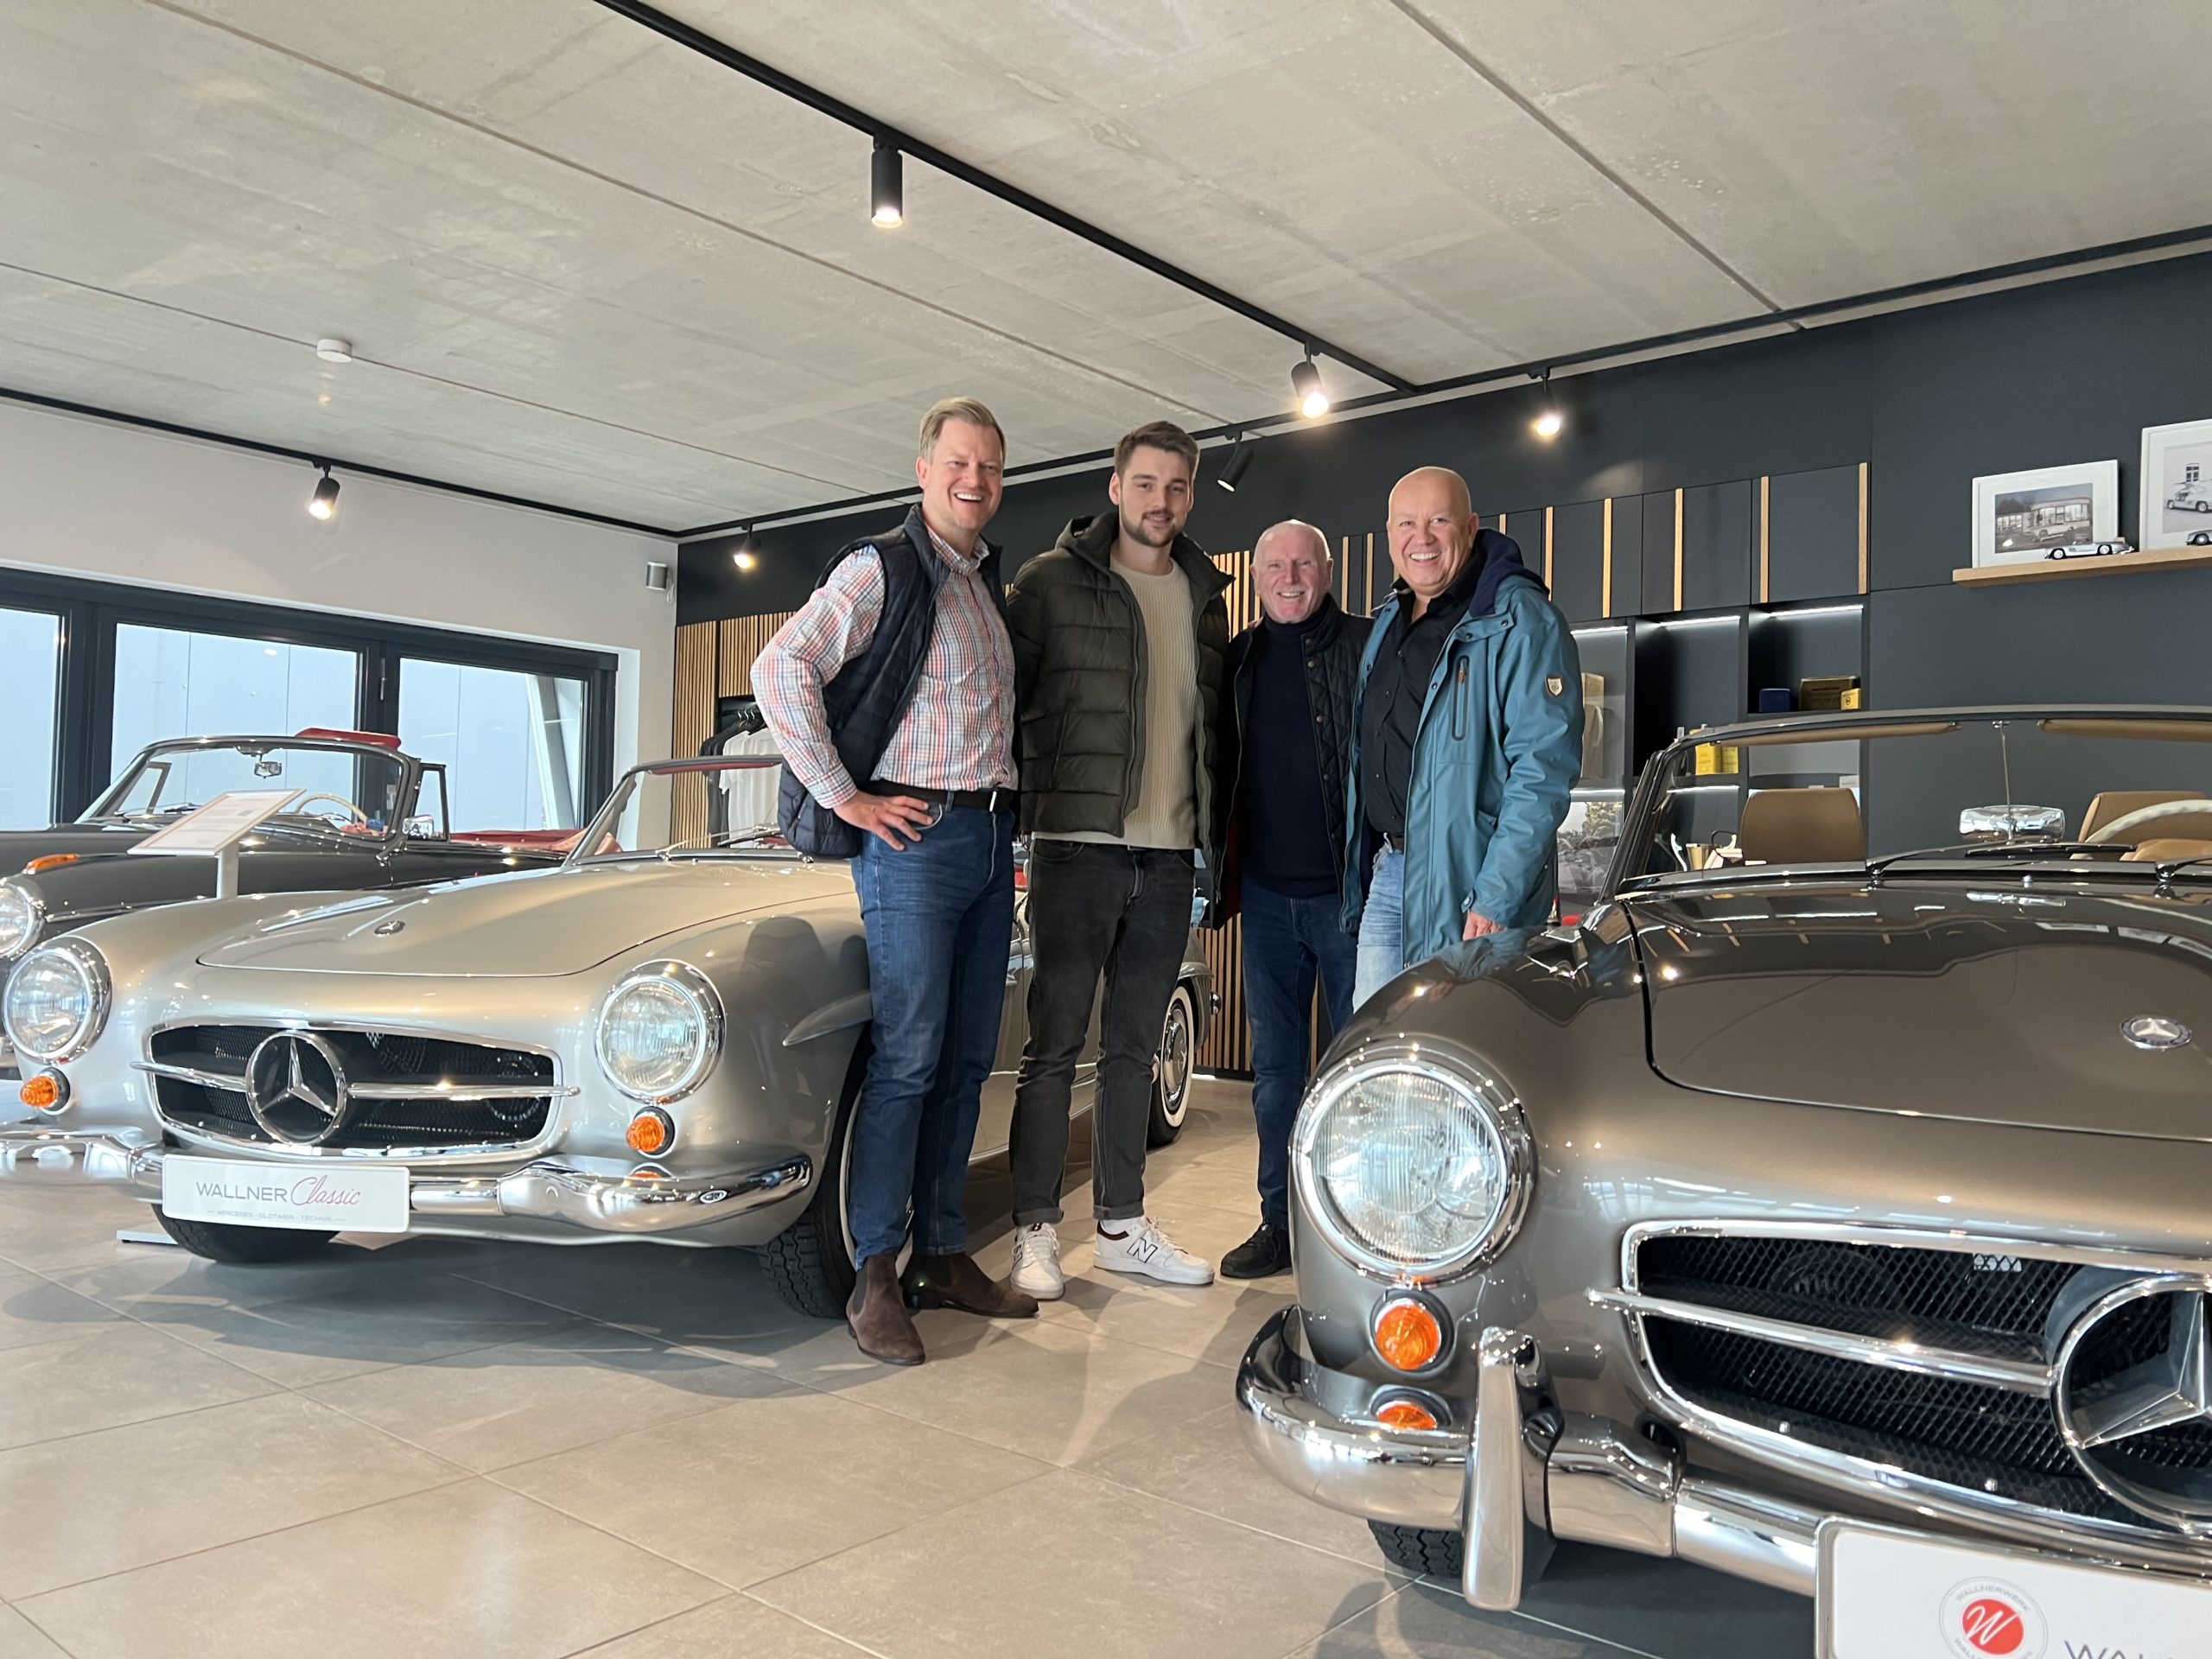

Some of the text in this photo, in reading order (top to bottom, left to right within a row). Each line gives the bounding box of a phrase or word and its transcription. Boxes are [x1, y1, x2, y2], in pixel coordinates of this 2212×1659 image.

[196, 1174, 361, 1206] WALLNER Classic
[217, 1210, 254, 1218] MERCEDES
[258, 1212, 295, 1221] OLDTIMER
[1127, 1236, 1159, 1264] N
